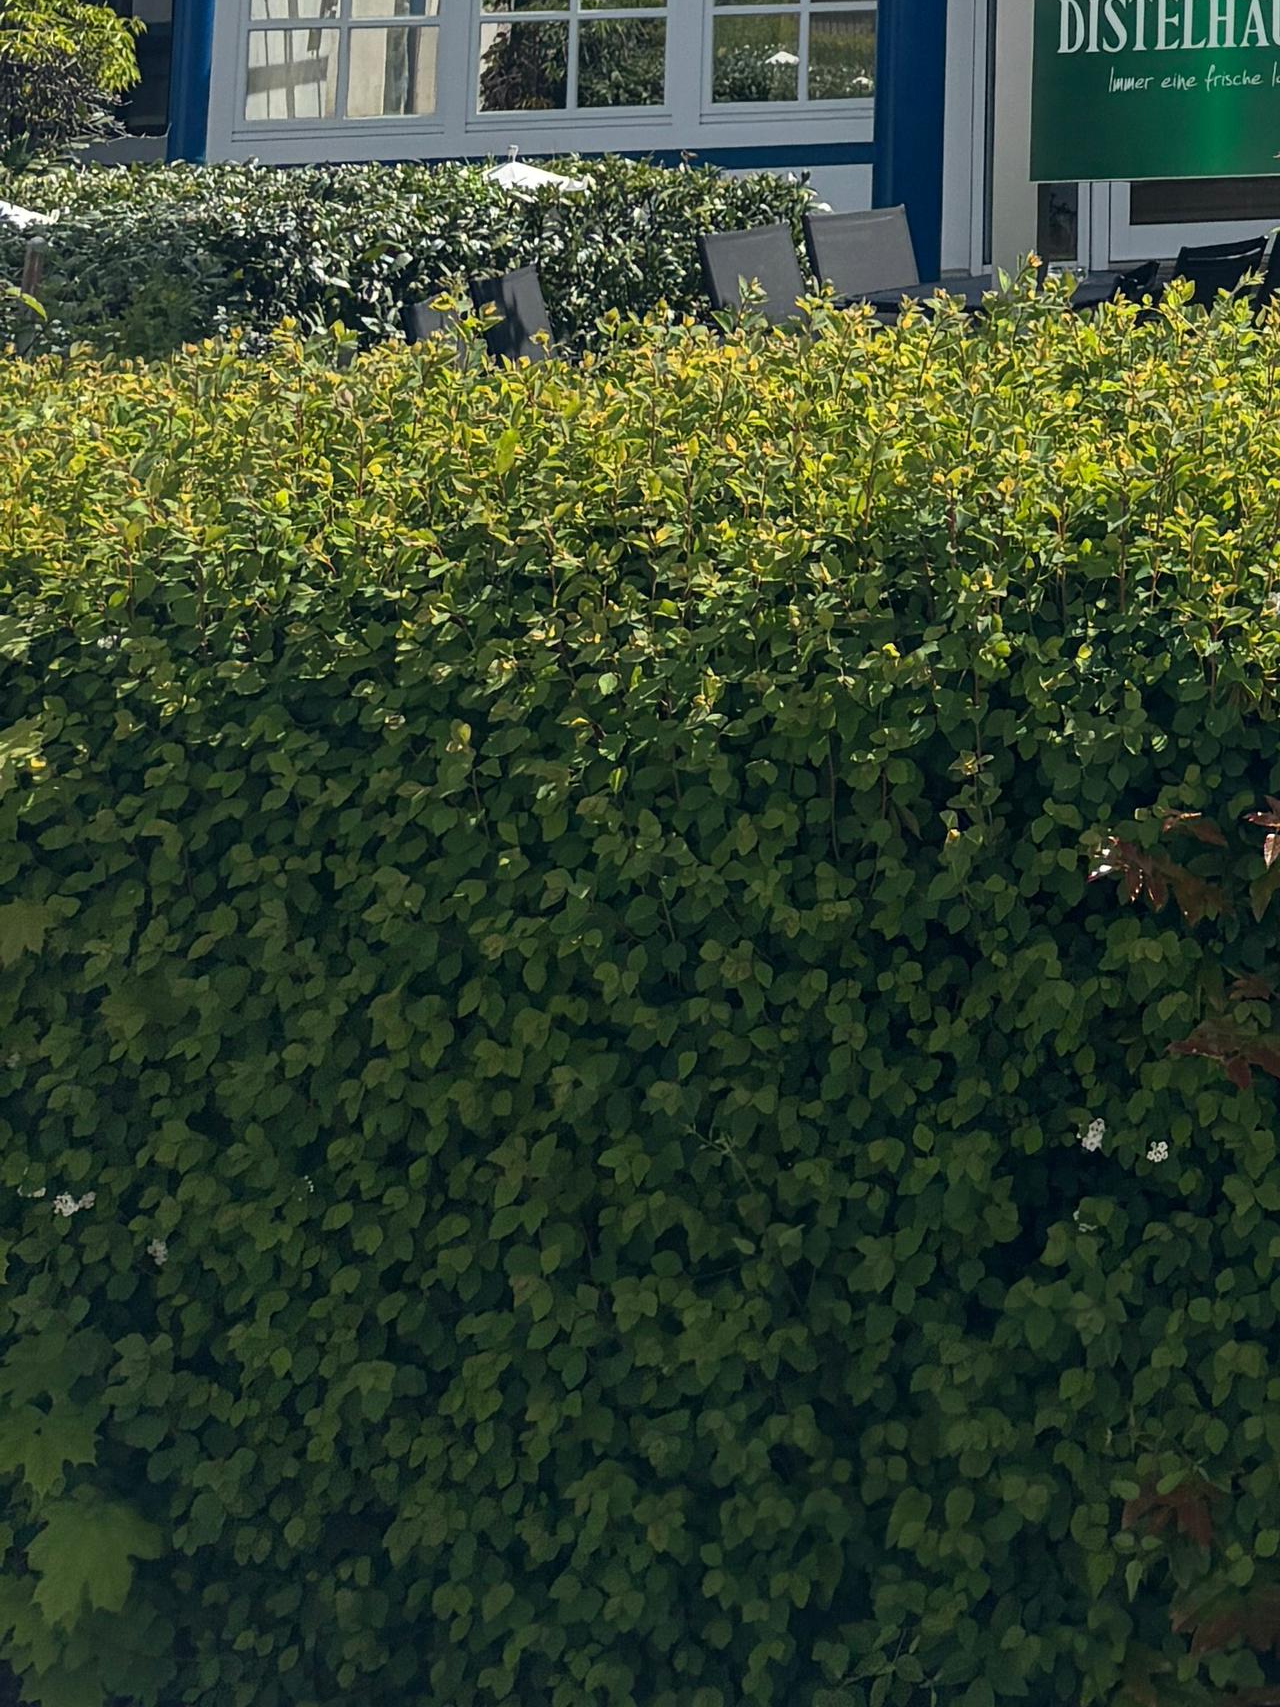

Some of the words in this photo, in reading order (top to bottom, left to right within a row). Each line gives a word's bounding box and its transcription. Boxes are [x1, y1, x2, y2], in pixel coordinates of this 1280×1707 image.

[1108, 66, 1154, 92] Immer
[1161, 72, 1197, 90] eine
[1204, 63, 1263, 92] frische
